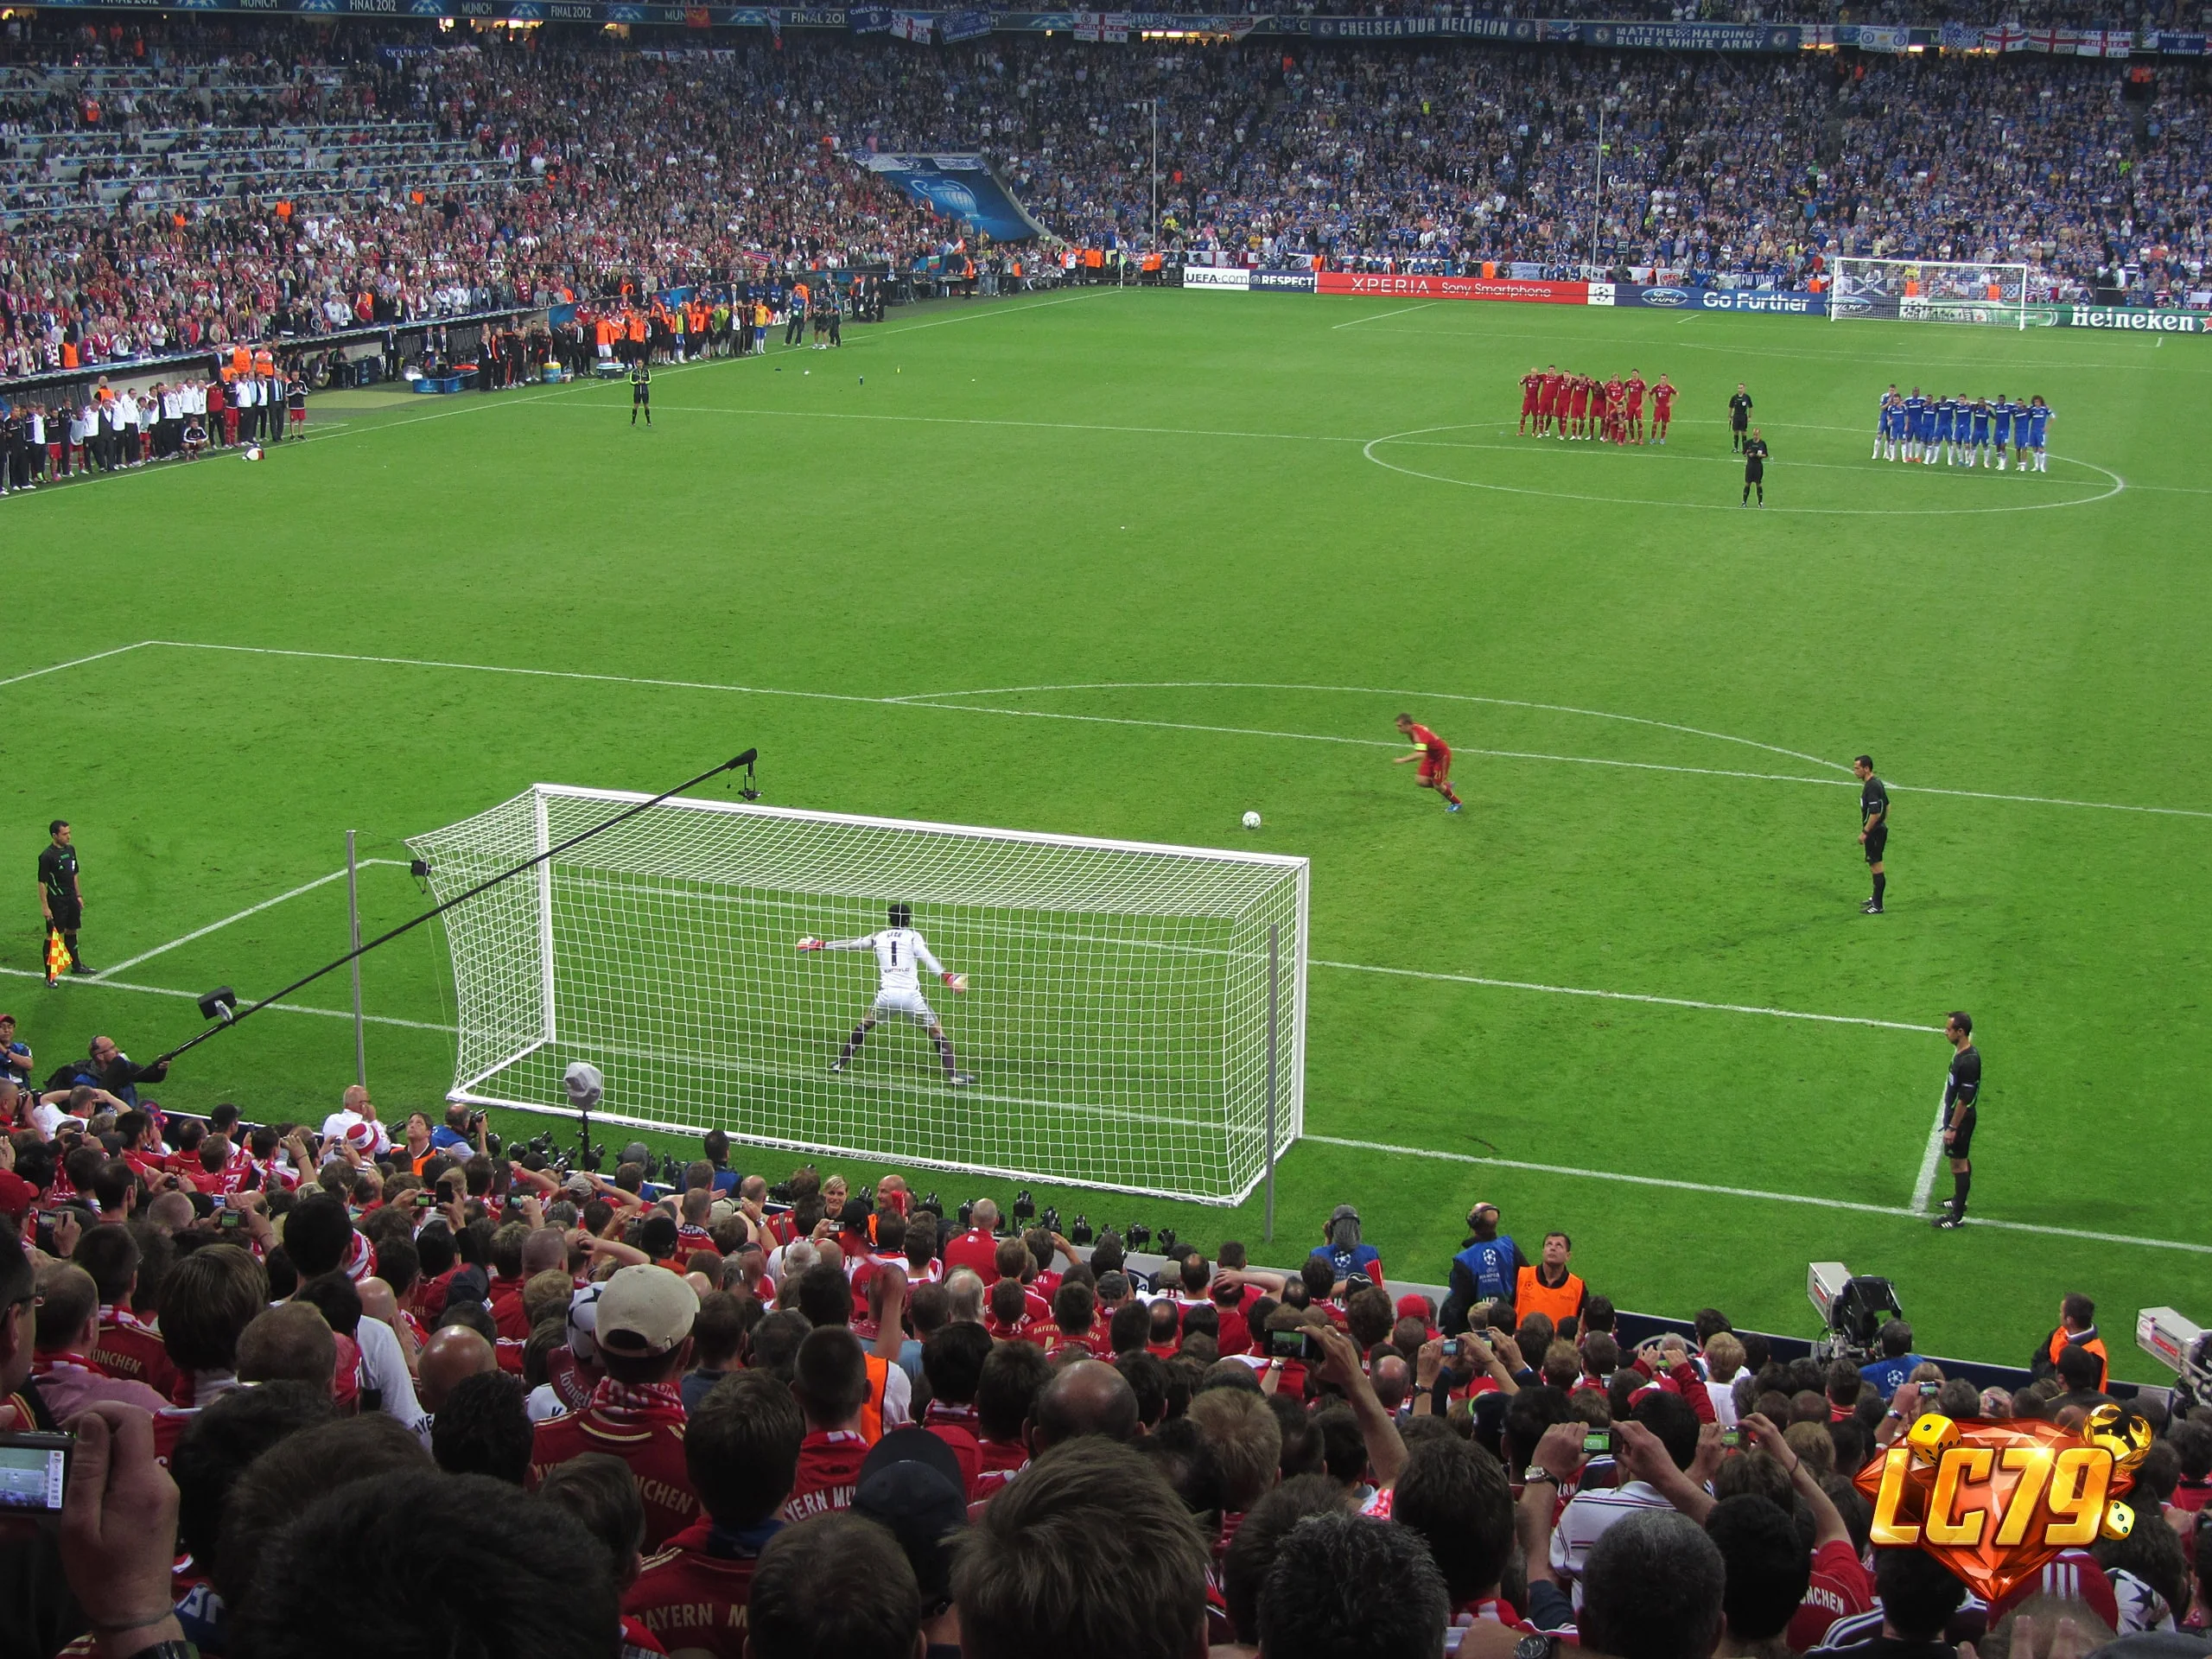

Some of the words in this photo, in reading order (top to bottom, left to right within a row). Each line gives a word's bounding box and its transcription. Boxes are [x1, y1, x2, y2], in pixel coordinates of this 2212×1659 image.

[350, 0, 375, 10] FINAL
[376, 0, 397, 11] 2012
[461, 3, 493, 15] MUNICH
[550, 5, 571, 17] FINAL
[572, 7, 592, 18] 2012
[850, 6, 883, 16] CHELSEA
[664, 10, 688, 22] MUN
[791, 12, 823, 23] FINAL
[1338, 20, 1402, 36] CHELSEA
[1408, 19, 1436, 34] OUR
[1441, 17, 1509, 36] RELIGION
[1692, 29, 1755, 40] HARDING
[1616, 35, 1651, 47] BLUE
[1655, 37, 1664, 48] &
[1668, 38, 1713, 49] WHITE
[1721, 40, 1764, 50] ARMY
[1262, 276, 1313, 288] RESPECT
[1351, 277, 1430, 294] XPERIA
[1441, 282, 1471, 296] Sony
[1475, 283, 1552, 297] Smartphone
[1649, 290, 1680, 303] Ford
[1703, 291, 1728, 308] Go
[1736, 293, 1809, 311] Further
[2070, 307, 2194, 331] Heineken
[891, 941, 897, 966] 1
